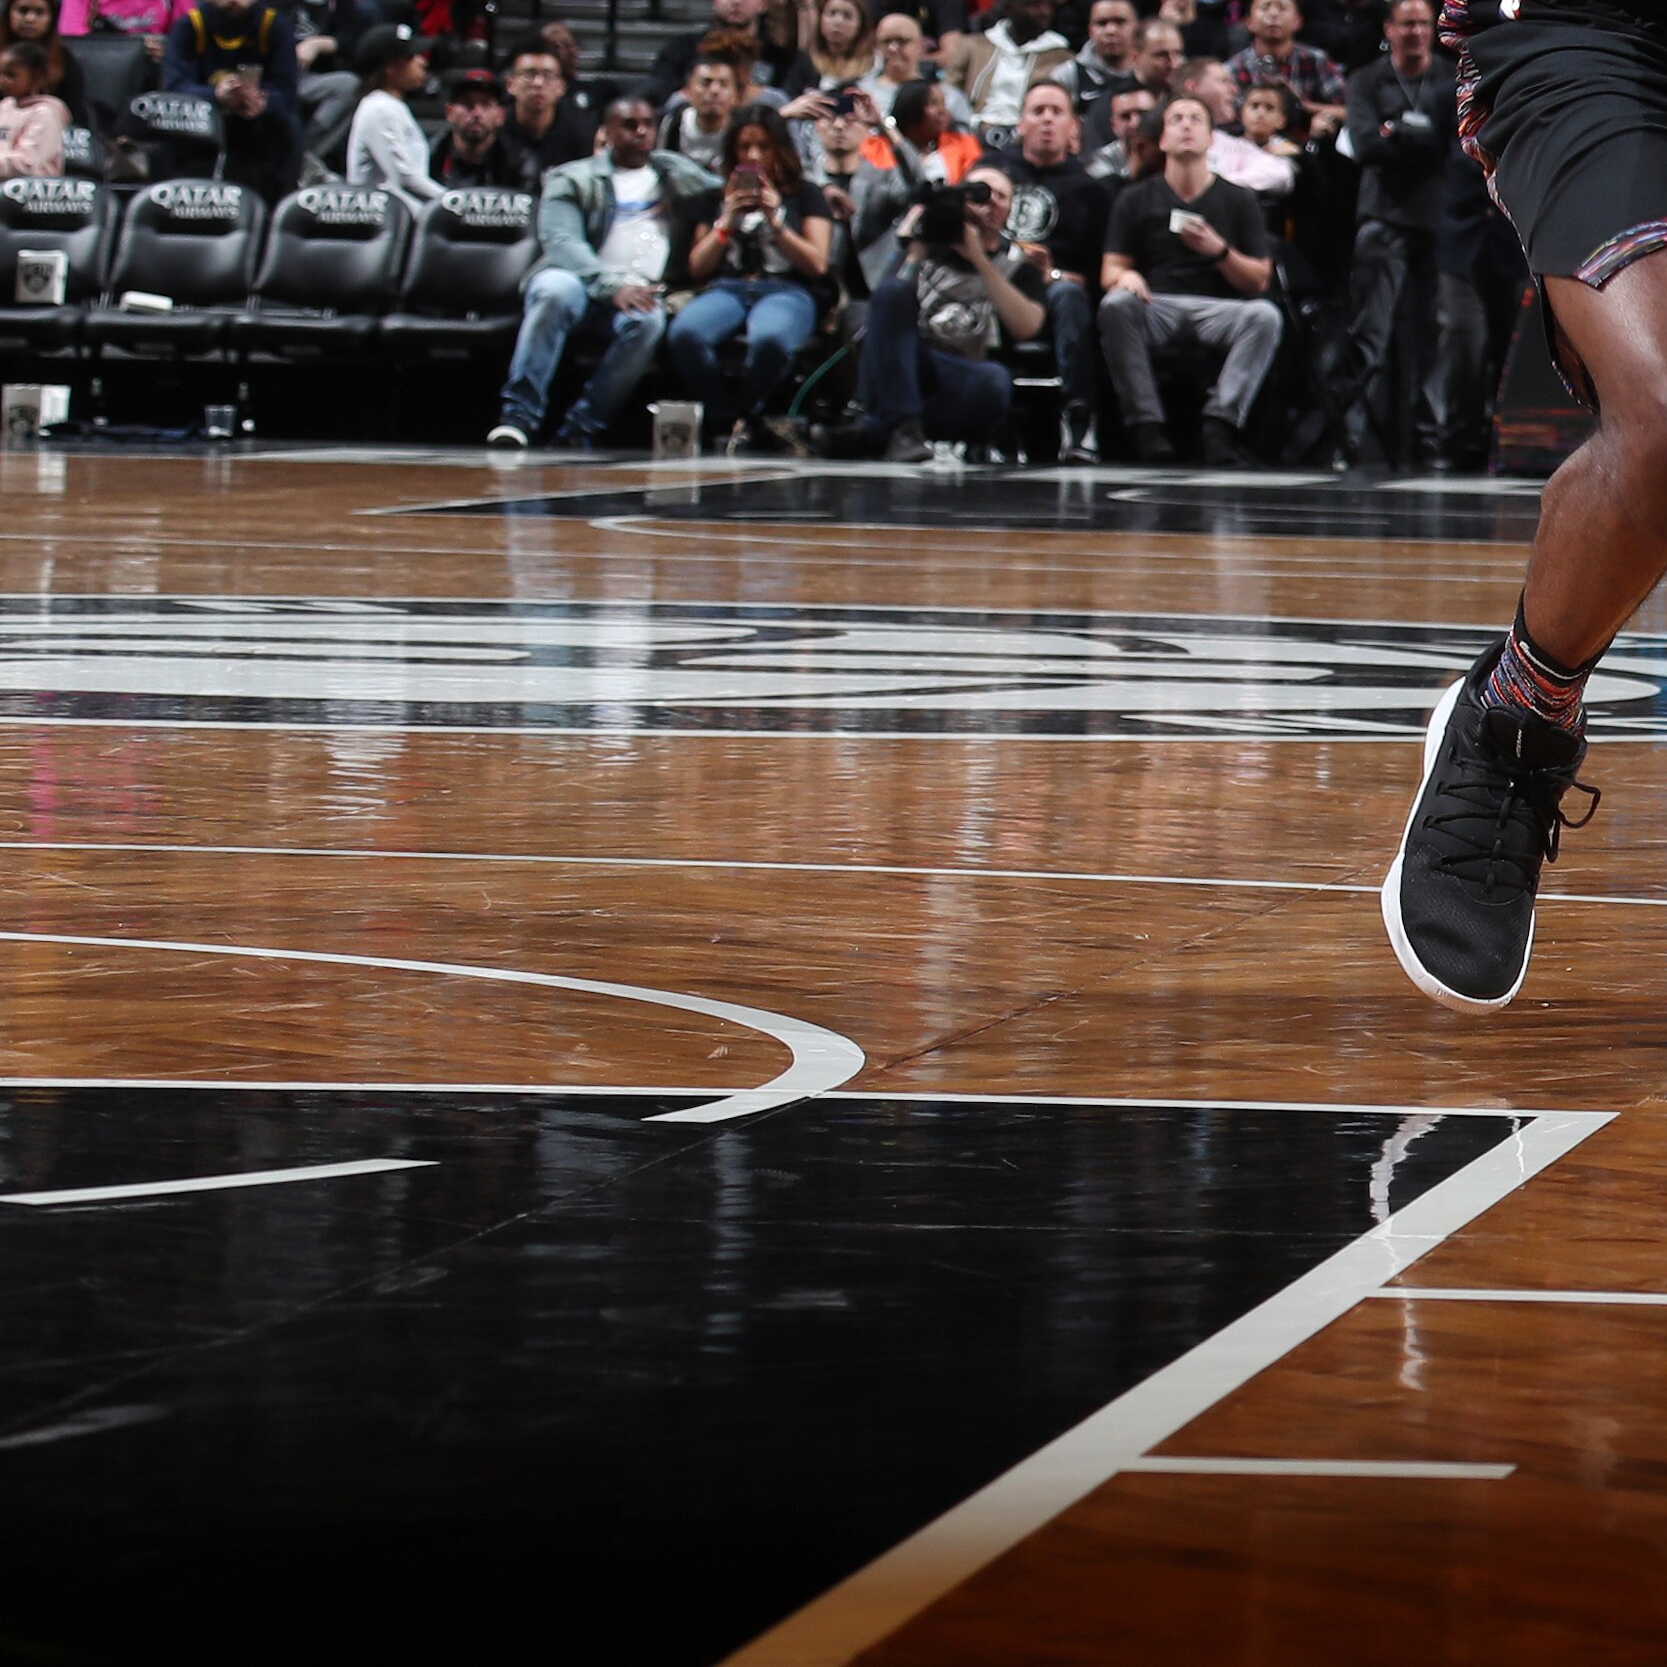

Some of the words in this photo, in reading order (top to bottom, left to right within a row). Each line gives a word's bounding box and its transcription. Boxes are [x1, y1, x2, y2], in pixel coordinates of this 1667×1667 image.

[3, 177, 97, 204] QATAR
[150, 184, 243, 210] QATAR
[297, 189, 389, 214] QATAR
[442, 189, 533, 216] QATAR
